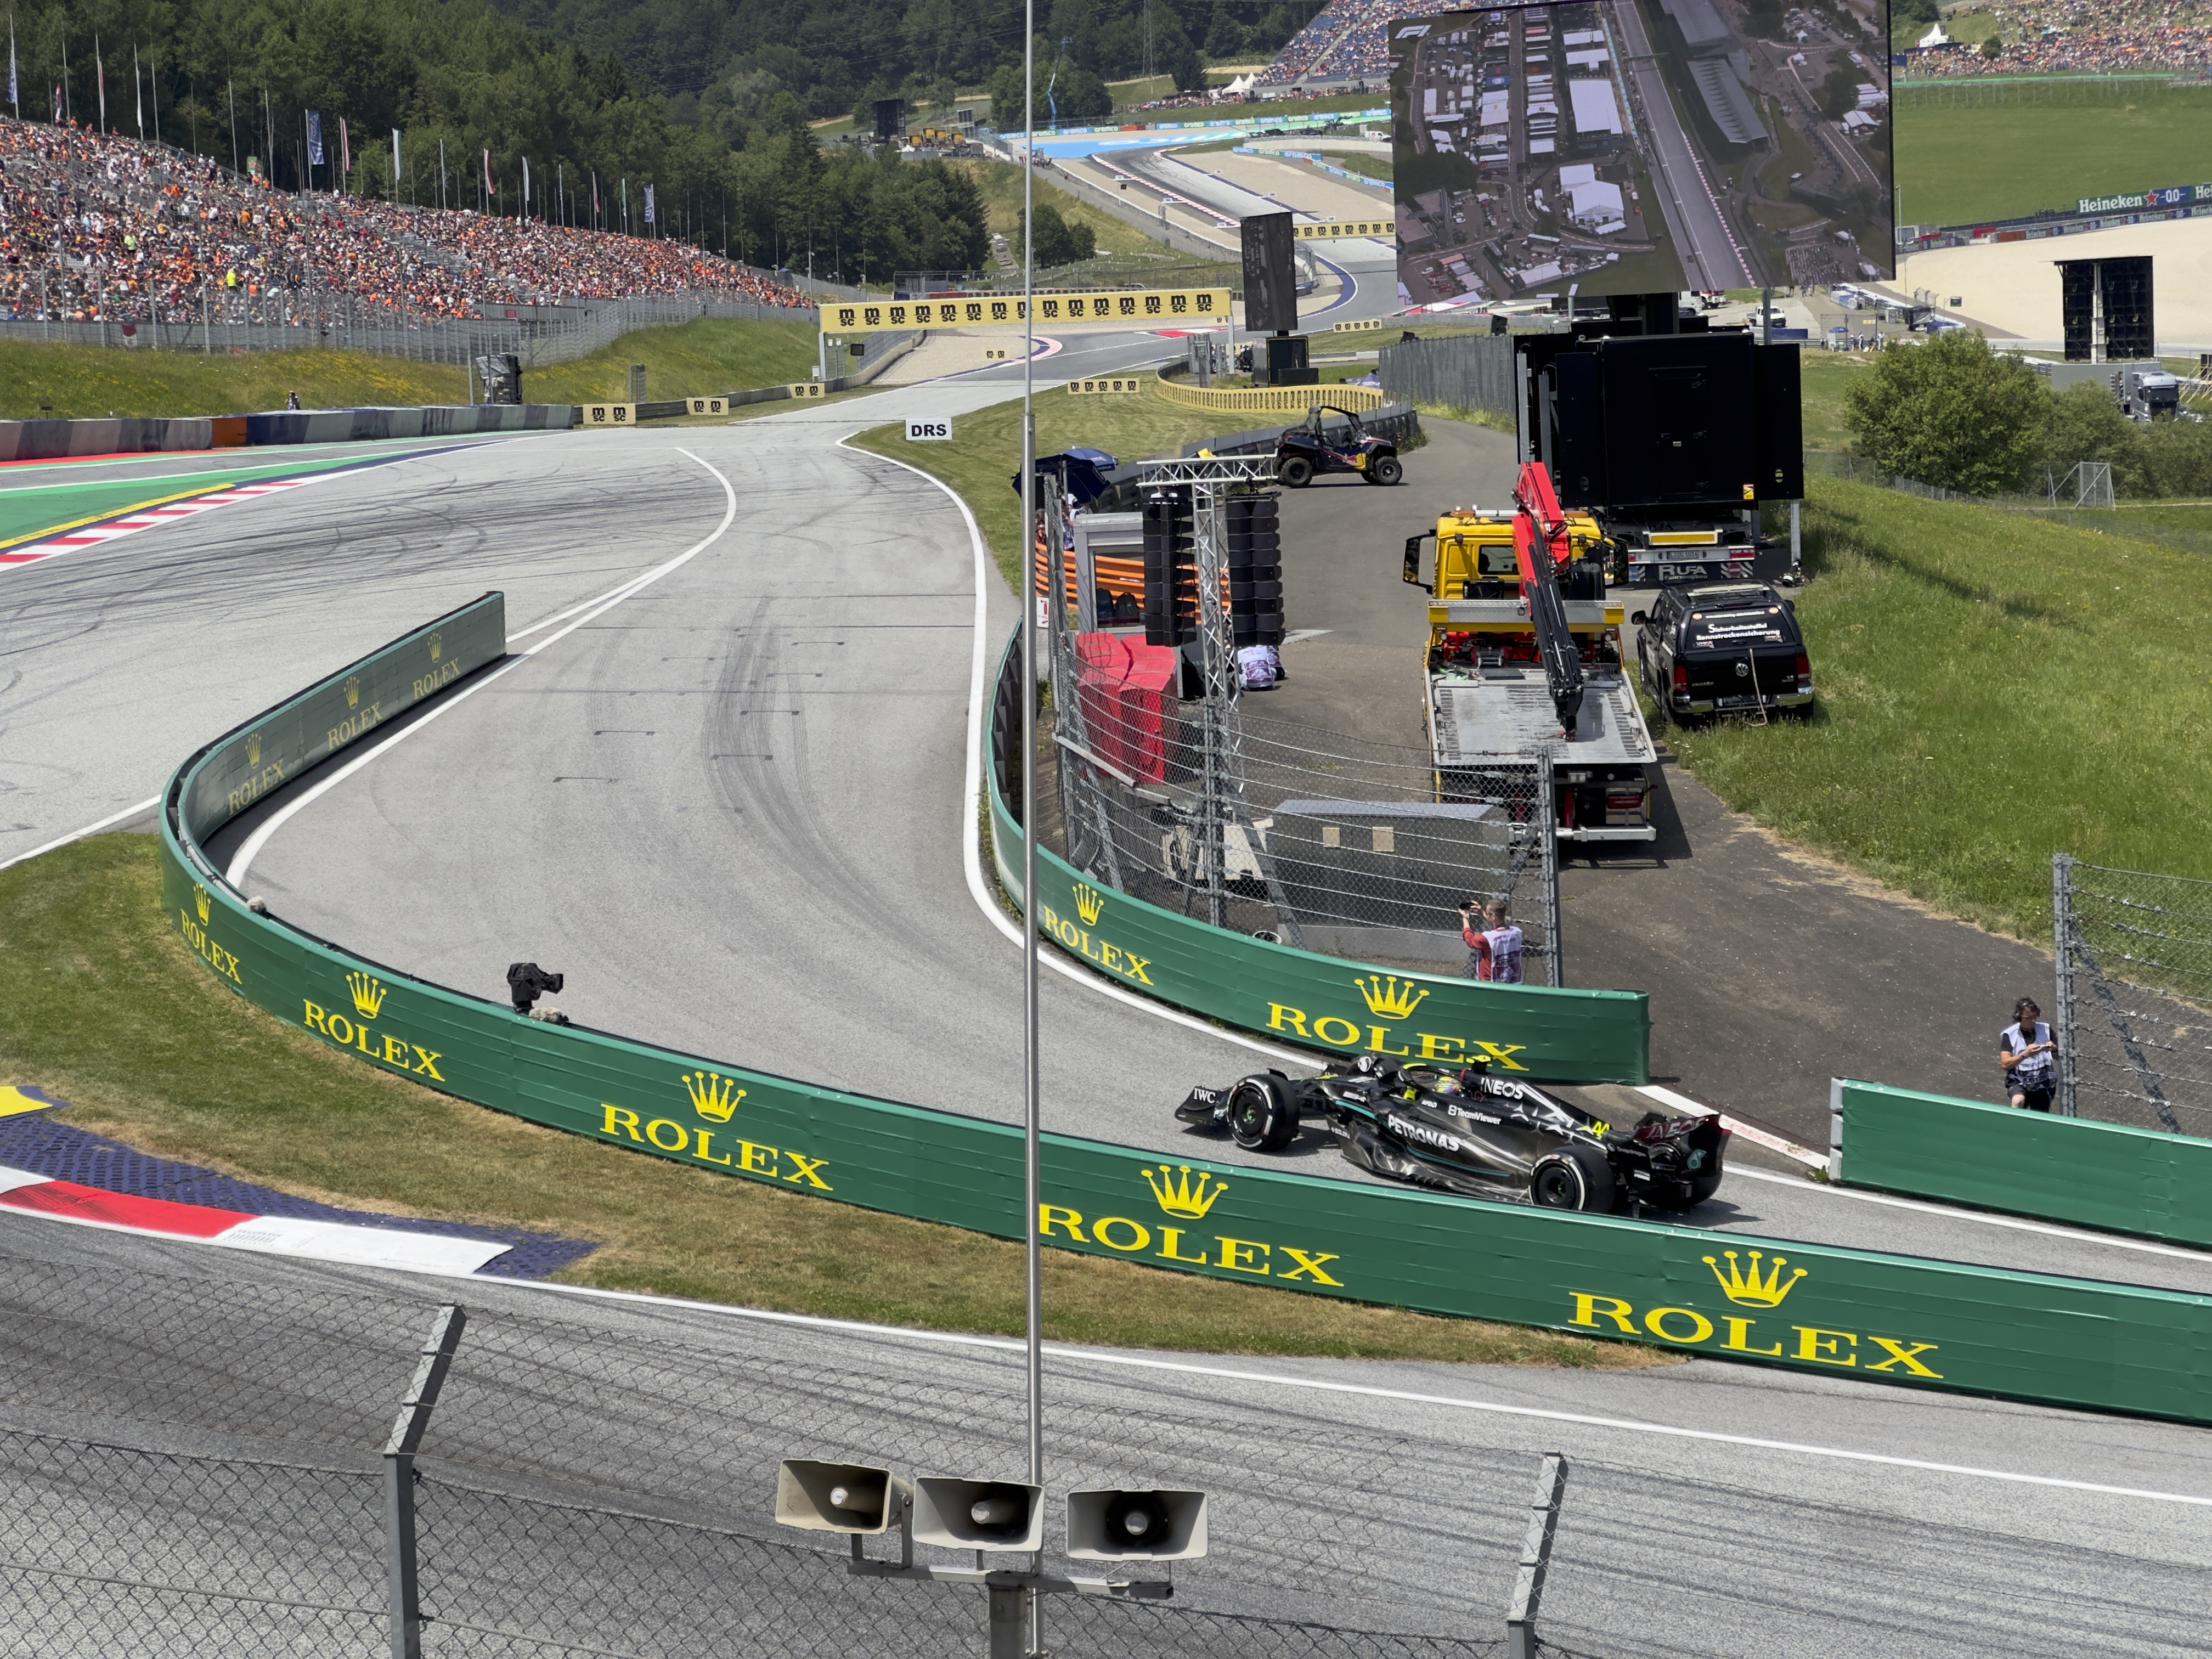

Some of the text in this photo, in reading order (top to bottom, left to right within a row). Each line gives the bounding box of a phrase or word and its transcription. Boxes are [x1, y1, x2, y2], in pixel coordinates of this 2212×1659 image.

[1284, 151, 1312, 159] aramco
[1363, 179, 1385, 188] aramco
[2079, 195, 2142, 213] Heineken
[911, 424, 947, 437] DRS
[1658, 564, 1707, 580] RUFA
[1696, 629, 1780, 641] Rennstreckensicherung
[1708, 623, 1768, 634] Sicherheitsstaffel
[413, 658, 461, 700] ROLEX
[328, 701, 383, 751] ROLEX
[228, 759, 286, 816] ROLEX
[180, 909, 242, 985] ROLEX
[1043, 905, 1154, 986] ROLEX
[303, 998, 445, 1082] ROLEX
[1266, 1002, 1530, 1071] ROLEX
[1193, 1088, 1216, 1104] IWC
[1481, 1077, 1523, 1100] INEOS
[1457, 1107, 1502, 1125] TeamViewer
[600, 1103, 833, 1191] ROLEX
[1388, 1114, 1462, 1152] PETRONAS
[1616, 1146, 1647, 1157] Snapdragon
[1039, 1203, 1344, 1287] ROLEX
[1568, 1291, 1944, 1379] ROLEX
